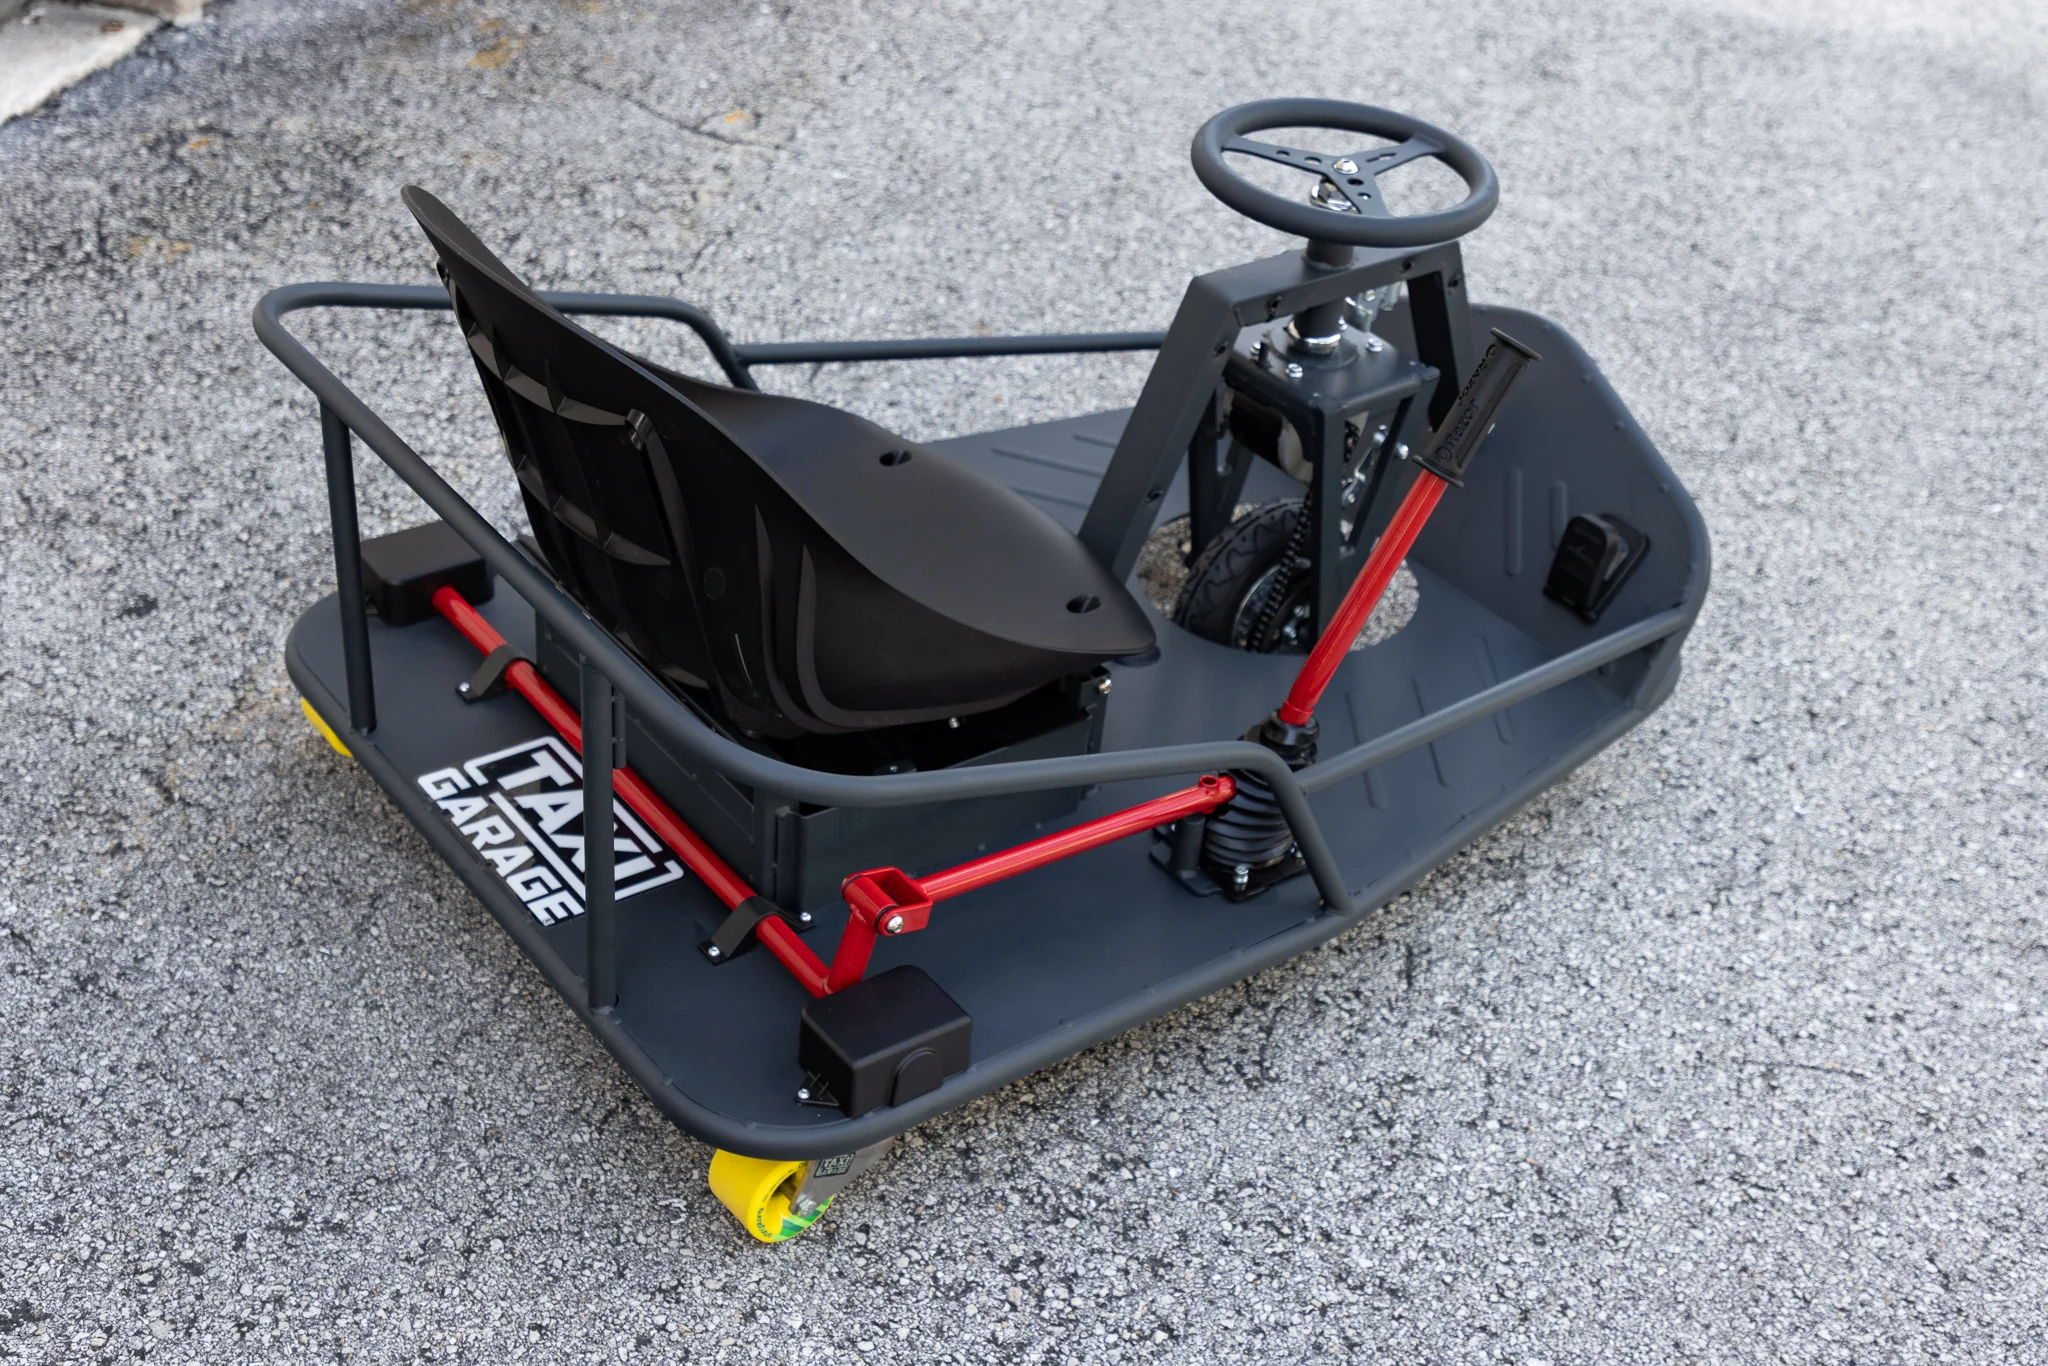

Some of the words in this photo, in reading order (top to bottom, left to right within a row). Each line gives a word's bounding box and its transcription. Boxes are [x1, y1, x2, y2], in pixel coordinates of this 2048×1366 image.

[1444, 398, 1479, 449] Razor
[497, 750, 656, 882] TAXI
[417, 767, 586, 927] GARAGE
[815, 1167, 847, 1177] GARAGE
[823, 1156, 851, 1168] TAXI
